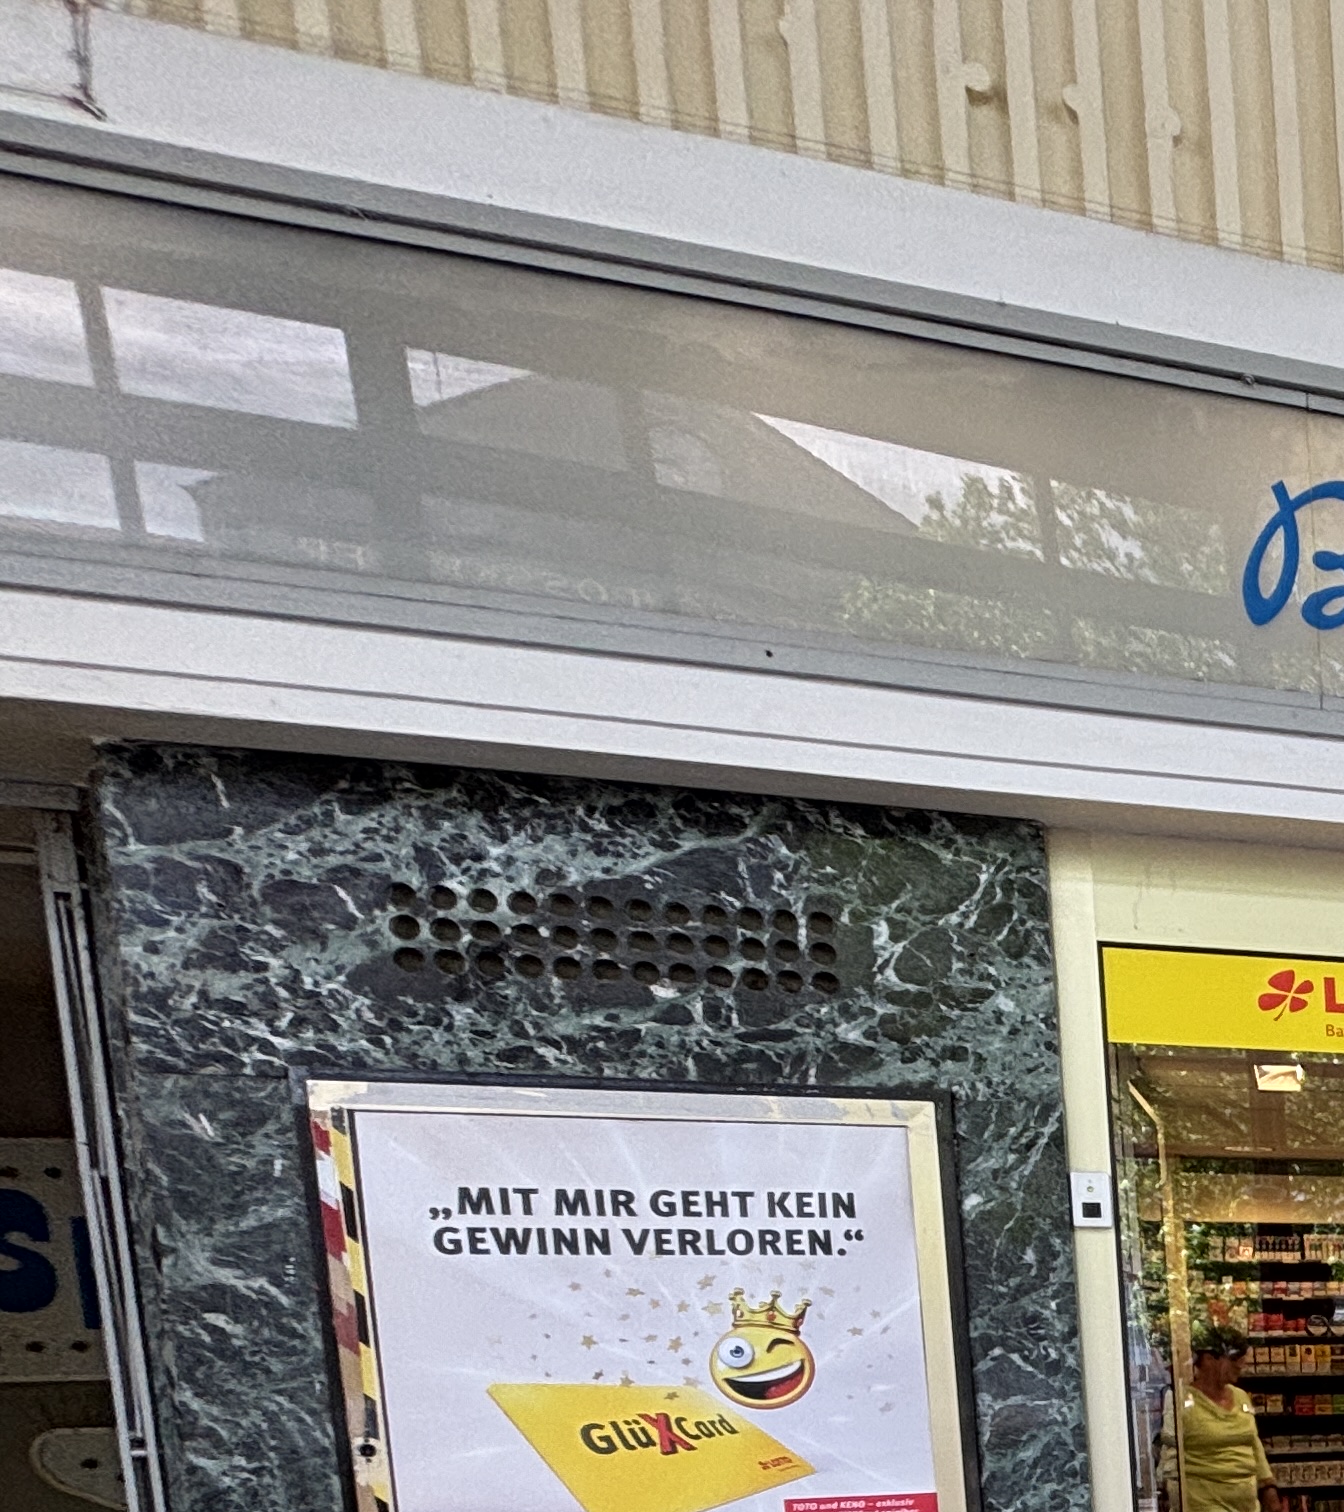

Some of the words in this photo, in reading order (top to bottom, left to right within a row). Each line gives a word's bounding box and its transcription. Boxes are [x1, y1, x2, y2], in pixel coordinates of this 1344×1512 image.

[429, 1186, 539, 1221] „MIT
[554, 1188, 638, 1218] MIR
[650, 1189, 755, 1219] GEHT
[767, 1191, 857, 1219] KEIN
[433, 1226, 612, 1256] GEWINN
[580, 1412, 741, 1457] GlüXCard
